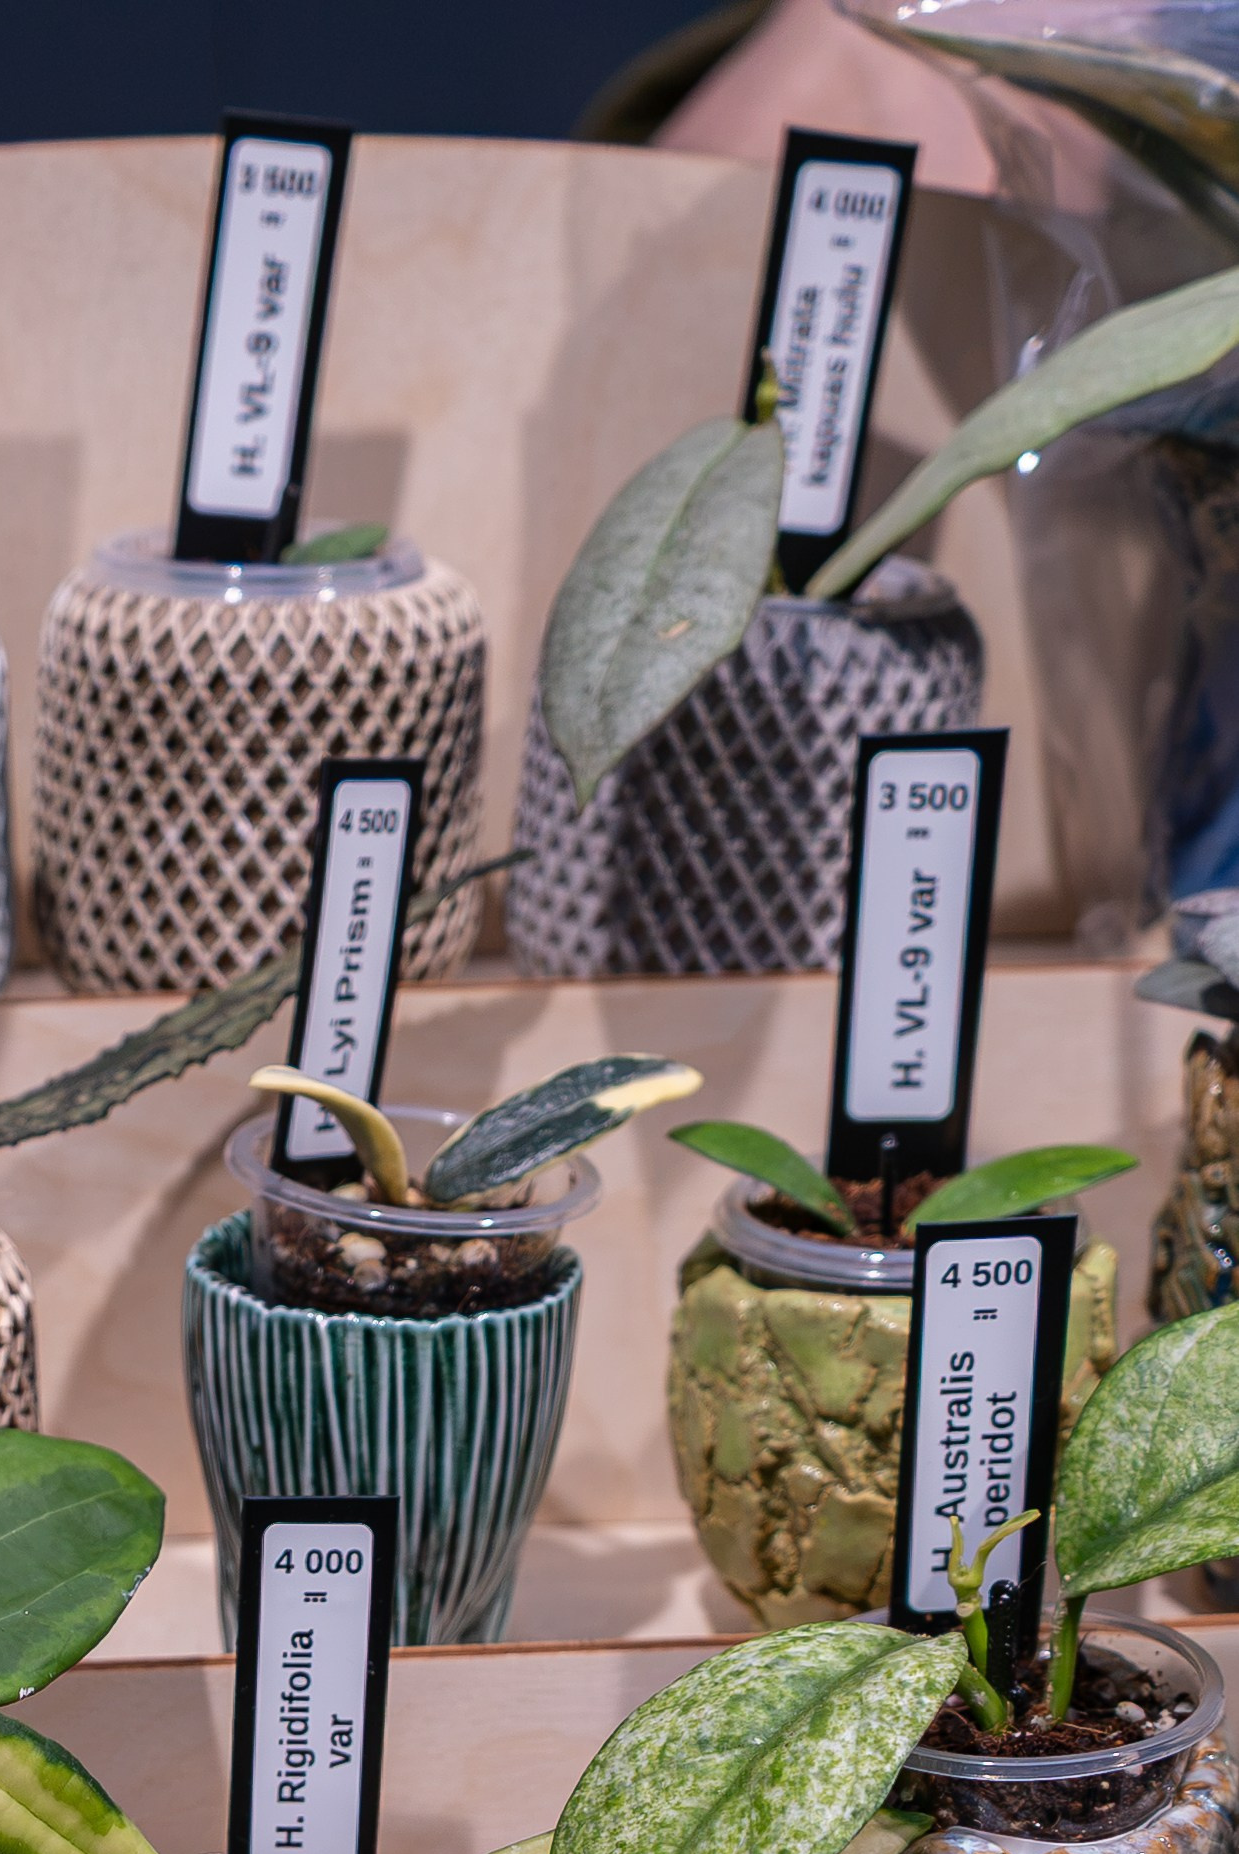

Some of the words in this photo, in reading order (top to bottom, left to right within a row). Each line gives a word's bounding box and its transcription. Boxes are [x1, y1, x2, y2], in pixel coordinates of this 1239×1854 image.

[229, 436, 265, 478] H.
[255, 253, 288, 320] var
[339, 809, 353, 833] 4
[359, 809, 399, 834] 500
[879, 782, 897, 810] 3
[909, 783, 969, 811] 500
[909, 870, 937, 934] var
[334, 879, 371, 1002] Prism
[894, 947, 931, 1037] VL-9
[324, 1018, 356, 1076] Lyi
[891, 1051, 923, 1089] H.
[941, 1263, 961, 1288] 4
[973, 1259, 1033, 1287] 500
[934, 1352, 974, 1523] Australis
[980, 1391, 1017, 1527] peridot
[275, 1549, 294, 1574] 4
[305, 1549, 363, 1574] 000
[277, 1629, 315, 1803] Rigidifolia
[329, 1714, 353, 1768] var
[275, 1816, 304, 1848] H.
